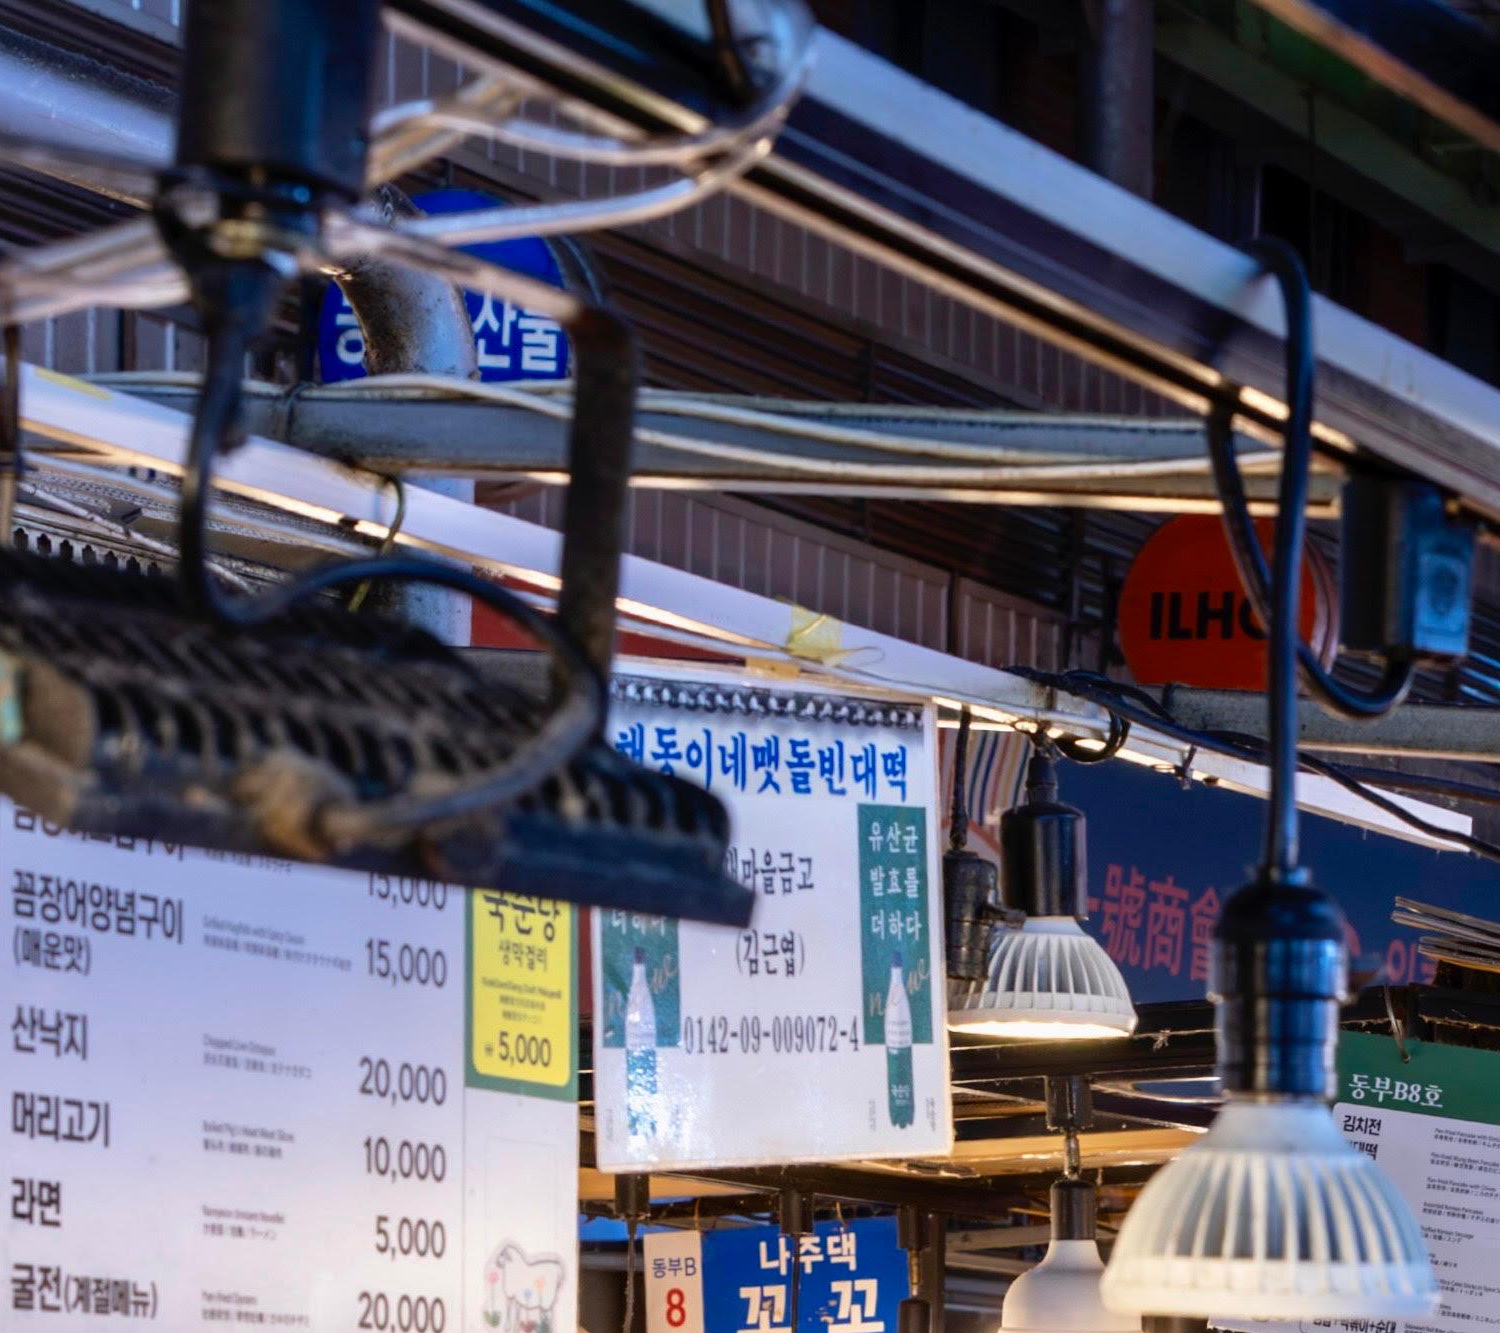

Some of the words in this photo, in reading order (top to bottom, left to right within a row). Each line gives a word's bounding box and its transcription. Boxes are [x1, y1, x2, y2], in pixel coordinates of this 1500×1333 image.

[869, 821, 920, 855] 유산균
[868, 865, 921, 900] 발효를
[870, 909, 922, 941] 더하다
[13, 925, 92, 976] (매운맛)
[364, 937, 448, 988] 15,000
[11, 1005, 88, 1061] 산낙지
[498, 1030, 552, 1068] 5,000
[358, 1056, 448, 1106] 20,000
[1348, 1072, 1444, 1108] 동부B8호
[11, 1090, 111, 1148] 머리고기
[1342, 1115, 1382, 1136] 김치전
[363, 1136, 448, 1183] 10,000
[10, 1177, 62, 1228] 라면
[375, 1215, 447, 1260] 5,000
[759, 1227, 858, 1276] 나주댁
[651, 1256, 697, 1279] 동부B
[665, 1287, 687, 1328] 8
